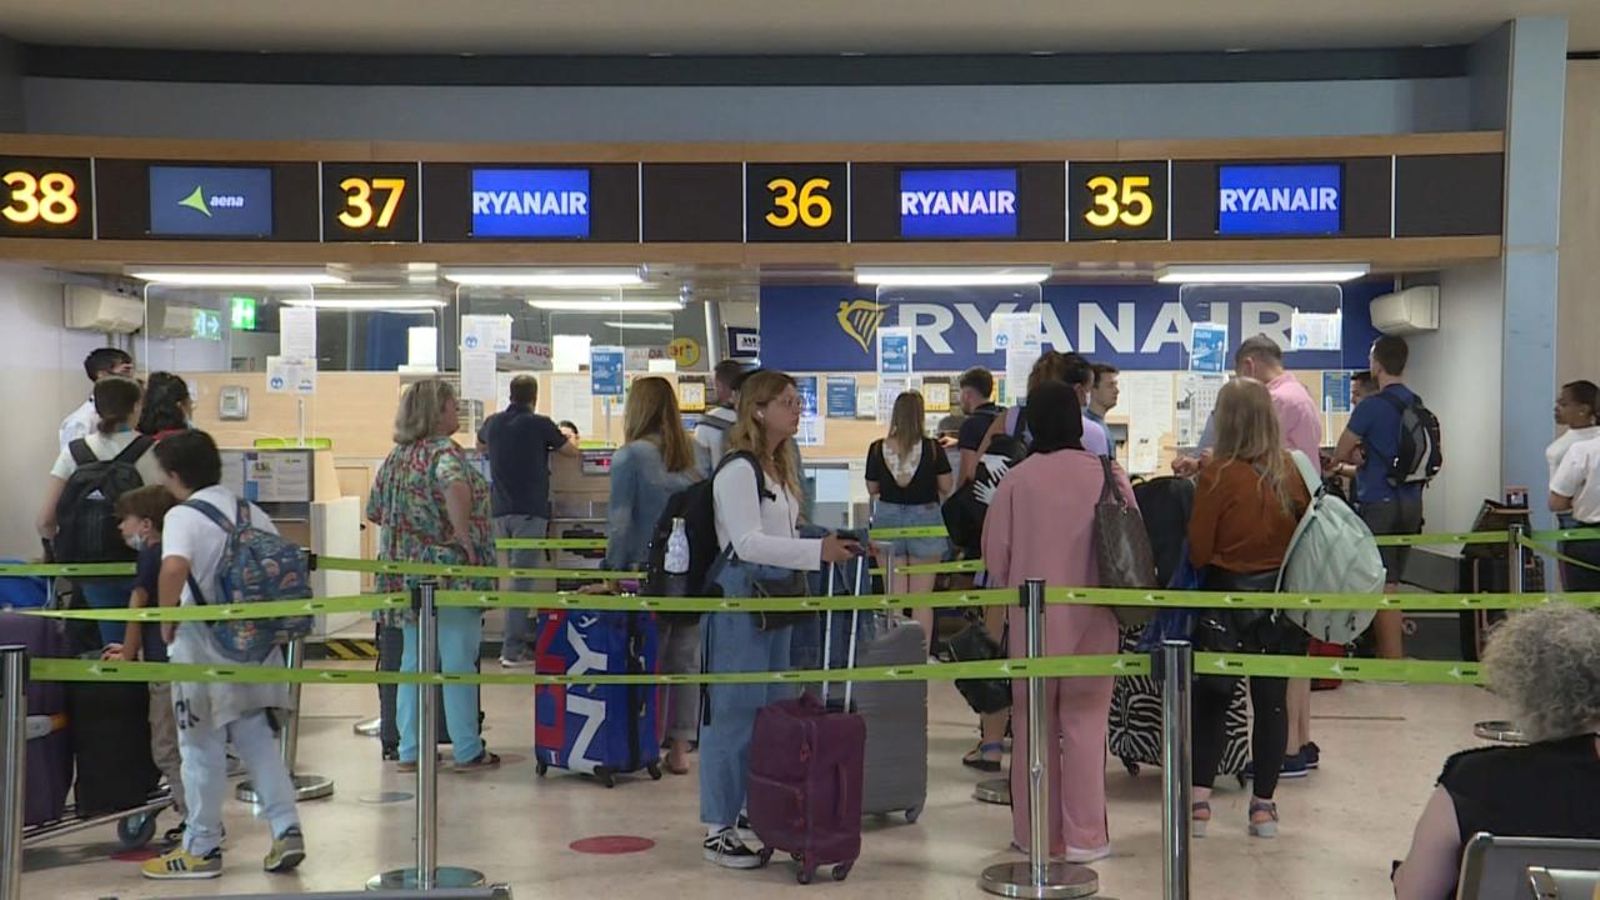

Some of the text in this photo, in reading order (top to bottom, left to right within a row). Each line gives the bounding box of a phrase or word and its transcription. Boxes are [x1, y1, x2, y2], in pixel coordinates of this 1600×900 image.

[1, 171, 78, 224] 38
[209, 193, 244, 208] aena
[337, 177, 406, 229] 37
[472, 190, 588, 216] RYANAIR
[765, 178, 832, 228] 36
[900, 190, 1016, 216] RYANAIR
[1084, 175, 1153, 227] 35
[1220, 187, 1338, 212] RYANAIR
[898, 301, 1299, 354] RYANAIR
